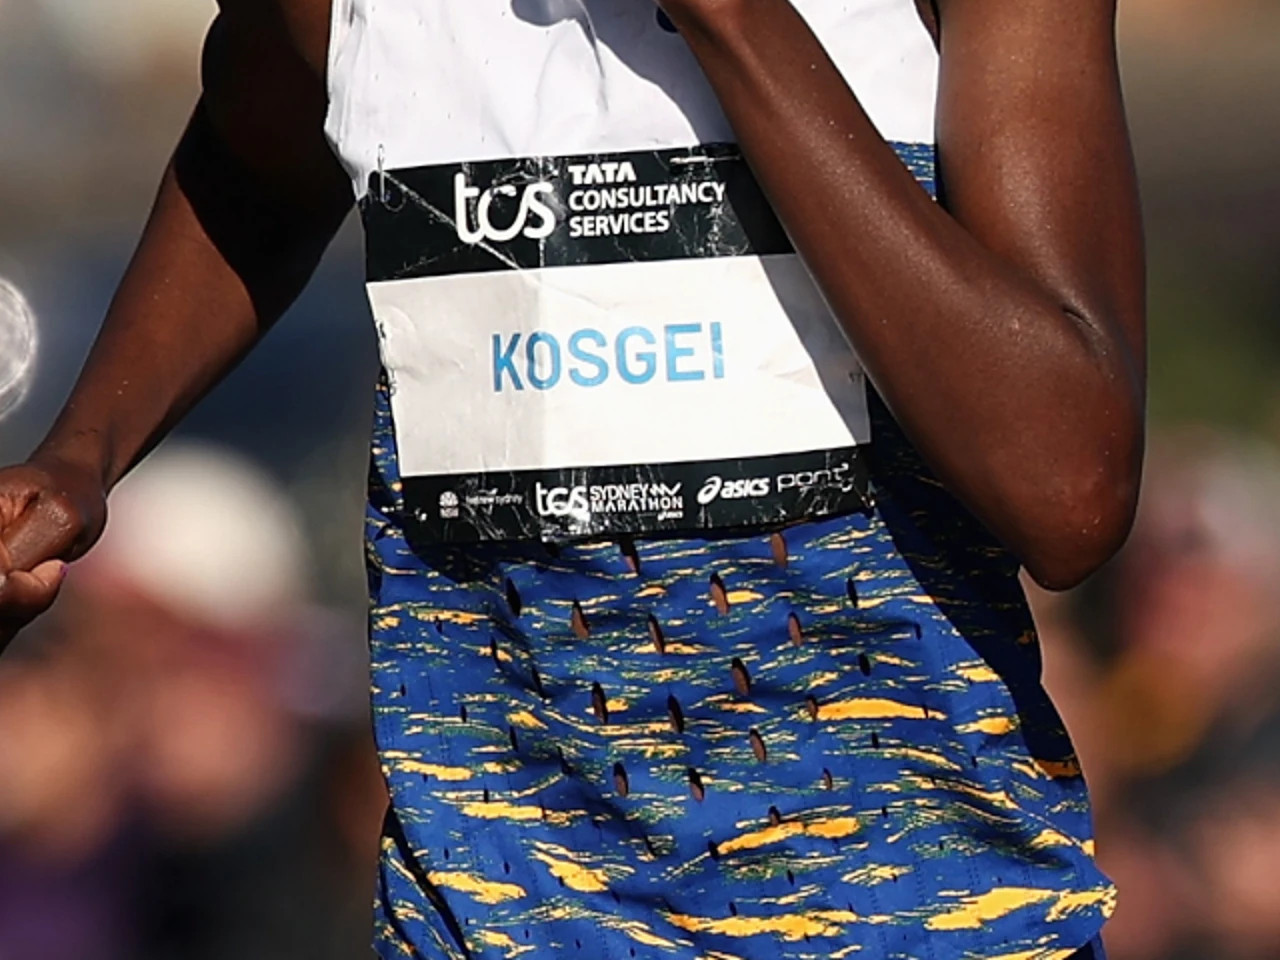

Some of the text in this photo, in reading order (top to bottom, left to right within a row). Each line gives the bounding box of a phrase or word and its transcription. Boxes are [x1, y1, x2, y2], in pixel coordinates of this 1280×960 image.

[568, 162, 636, 184] TATA
[454, 172, 556, 243] tcs
[568, 182, 725, 211] CONSULTANCY
[569, 211, 670, 237] SERVICES
[492, 321, 724, 393] KOSGEI
[536, 482, 590, 516] tcs
[590, 483, 649, 500] SYDNEY
[591, 496, 683, 513] MARATHON
